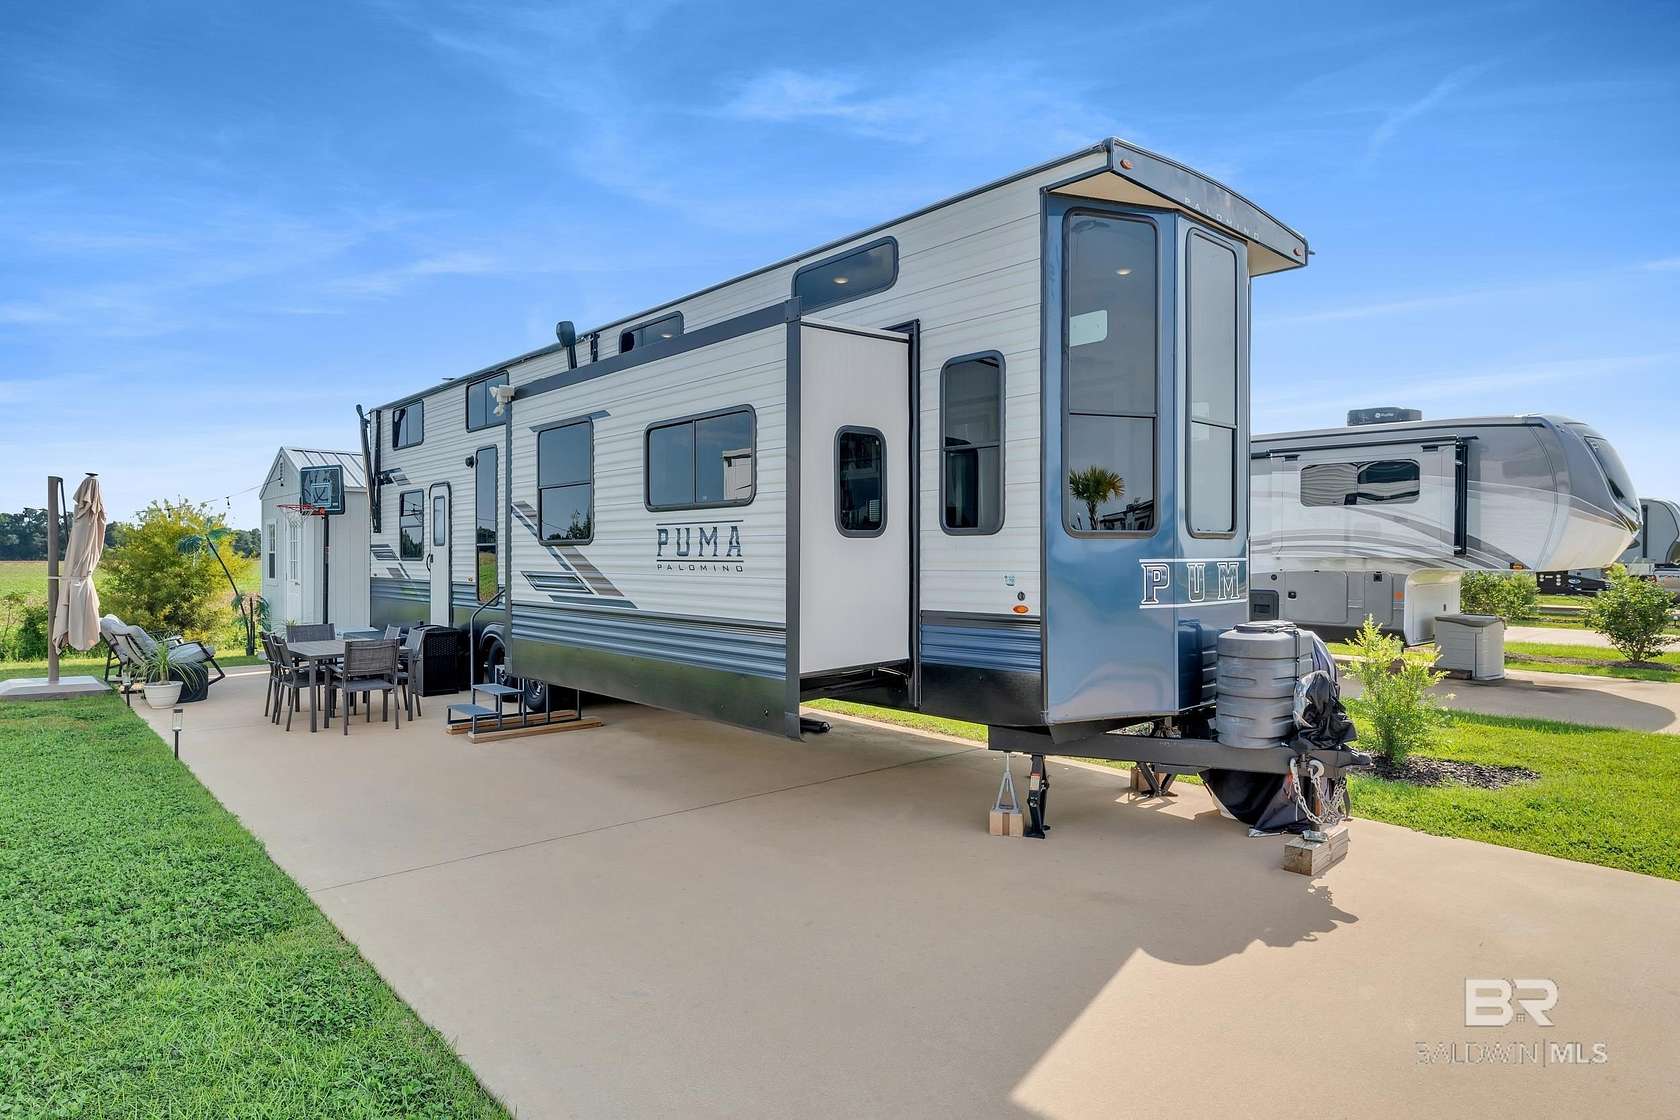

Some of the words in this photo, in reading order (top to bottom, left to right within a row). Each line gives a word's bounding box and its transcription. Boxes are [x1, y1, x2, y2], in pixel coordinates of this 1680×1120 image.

[656, 525, 743, 557] PUMA
[657, 564, 743, 572] PALOMINO
[1141, 562, 1240, 604] PUM
